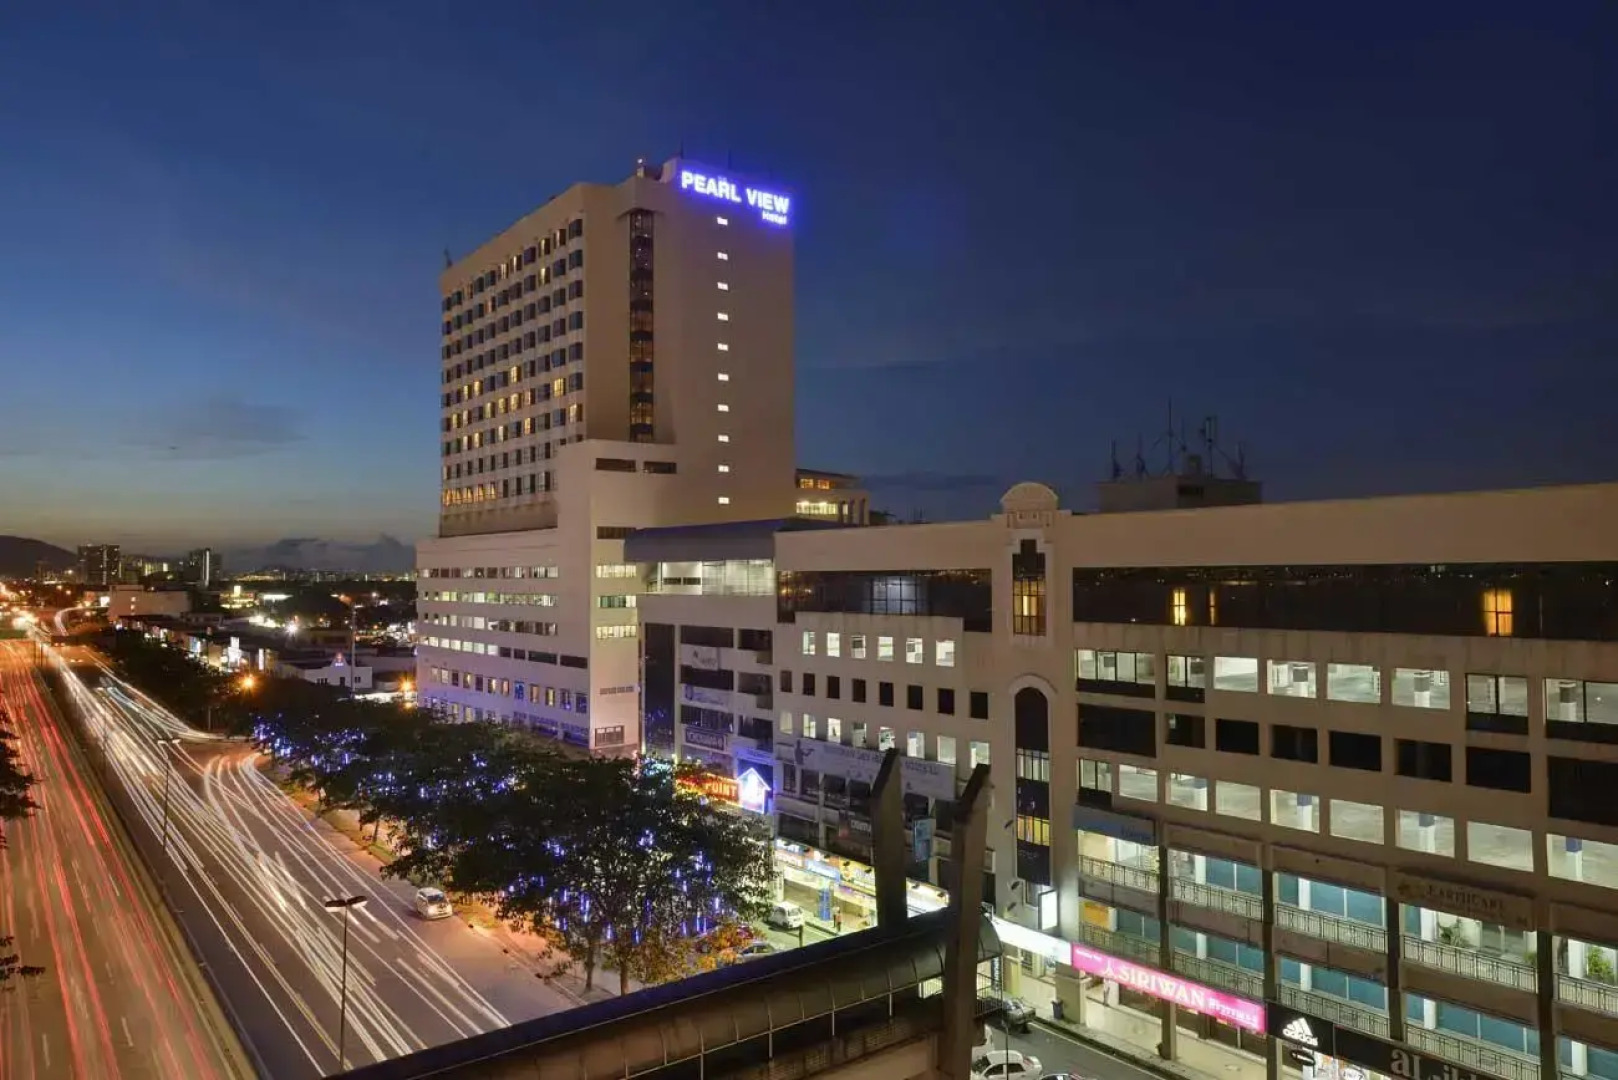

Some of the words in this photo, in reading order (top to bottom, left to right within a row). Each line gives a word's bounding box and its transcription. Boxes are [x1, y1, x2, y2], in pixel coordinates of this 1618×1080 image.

[681, 170, 741, 203] PEARL
[746, 188, 790, 214] VIEW
[1118, 966, 1205, 1009] SIRIWAN
[1282, 1028, 1319, 1047] adidas
